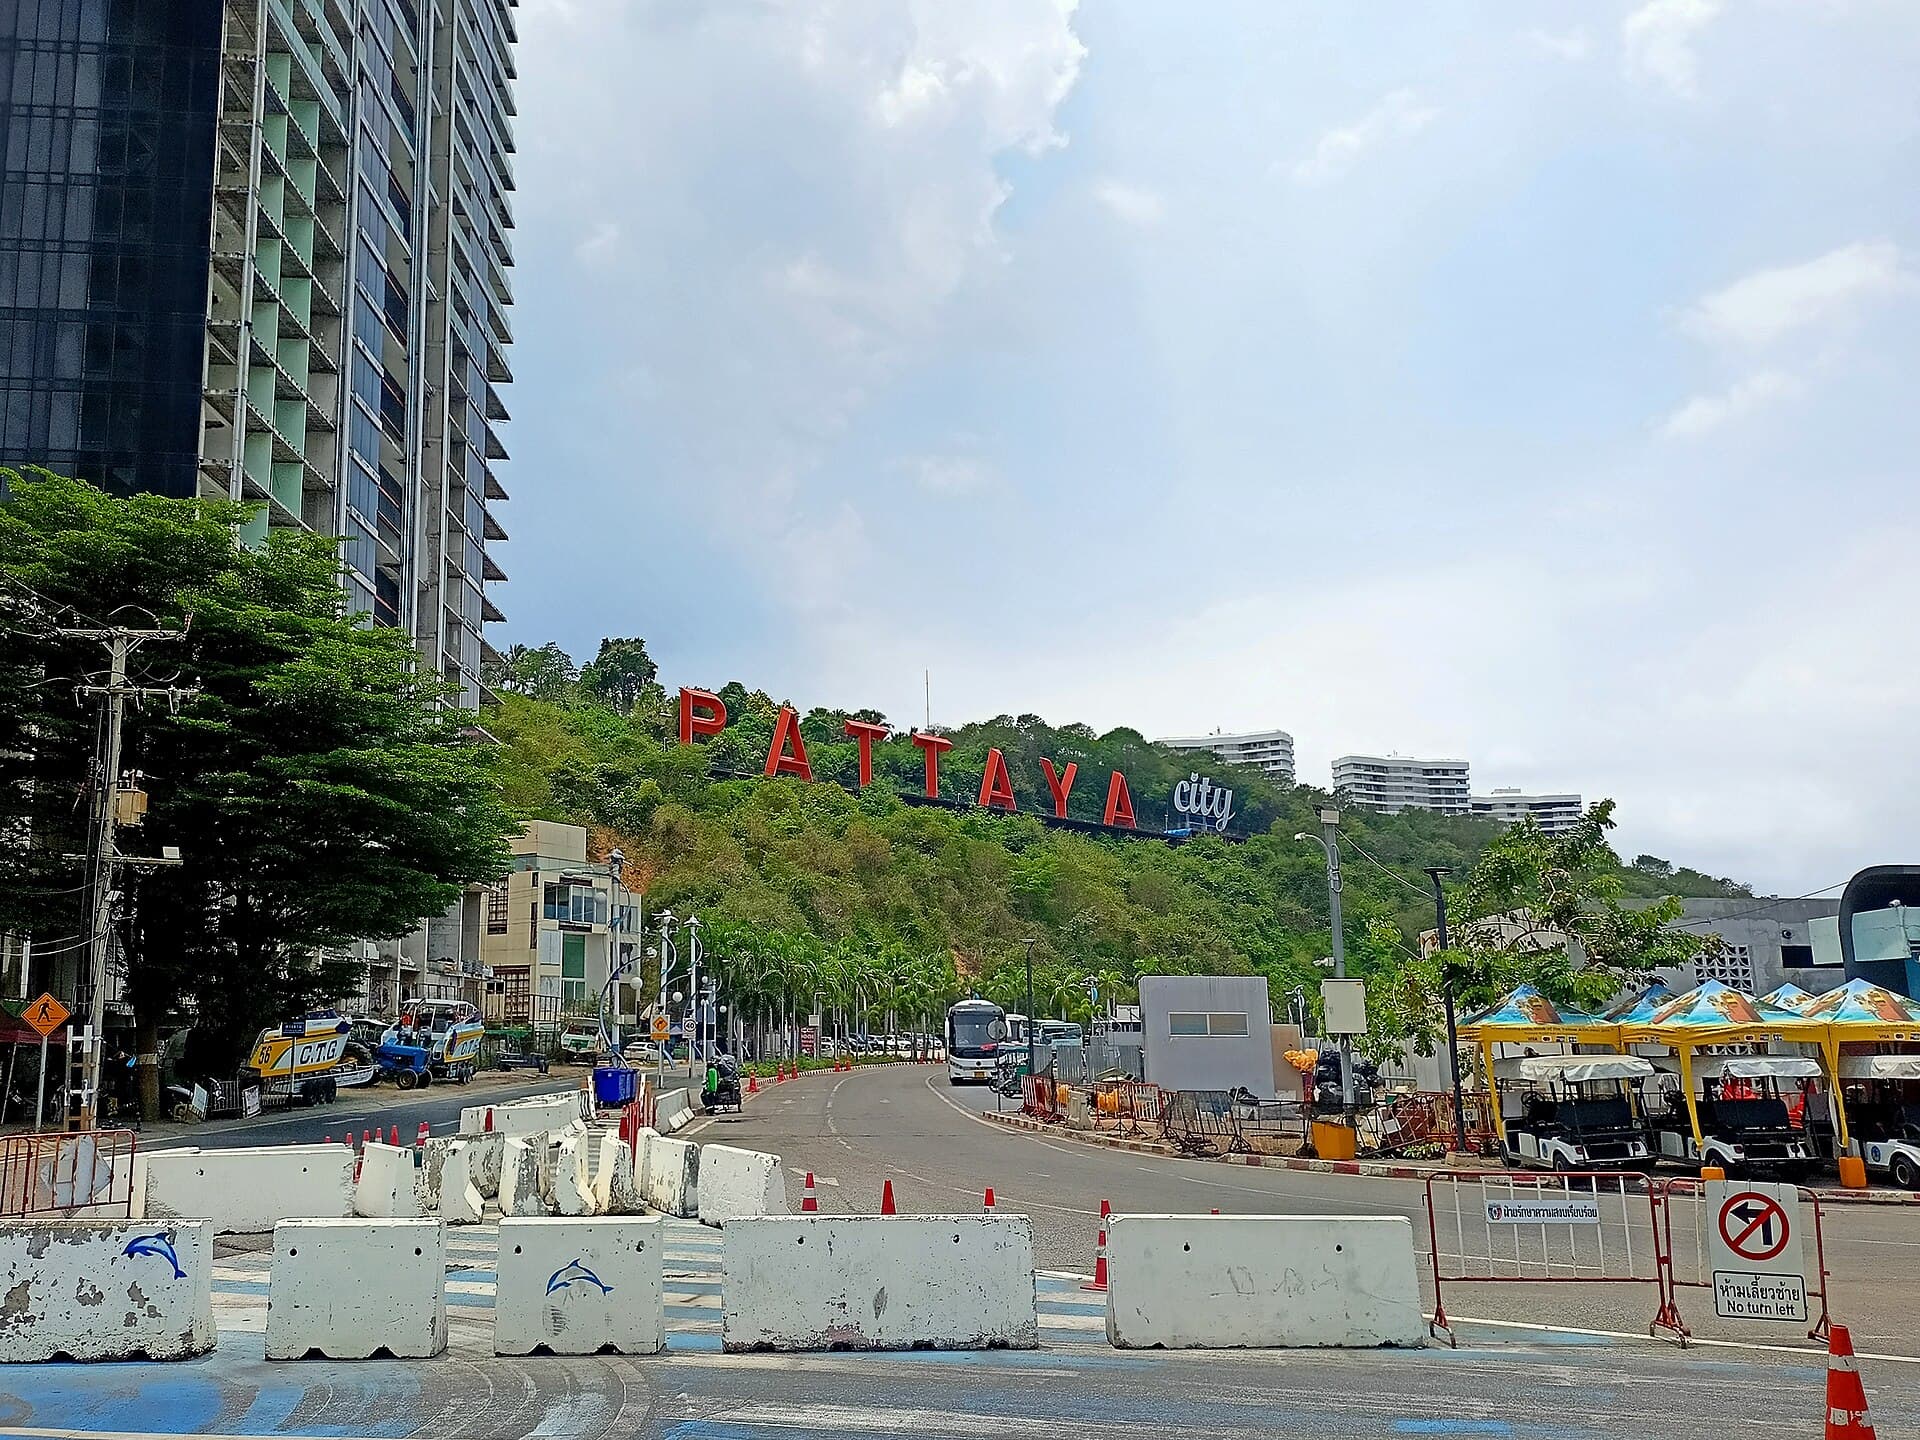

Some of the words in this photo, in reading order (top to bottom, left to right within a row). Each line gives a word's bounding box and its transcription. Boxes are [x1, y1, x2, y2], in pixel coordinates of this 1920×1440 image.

[679, 686, 1138, 830] PATTAYA
[1174, 772, 1236, 832] city
[258, 1045, 273, 1065] 56
[1719, 1275, 1800, 1301] ห้ามเลี้ยวซ้าย
[1727, 1299, 1744, 1313] No
[1747, 1301, 1772, 1314] turn
[1775, 1302, 1795, 1316] left
